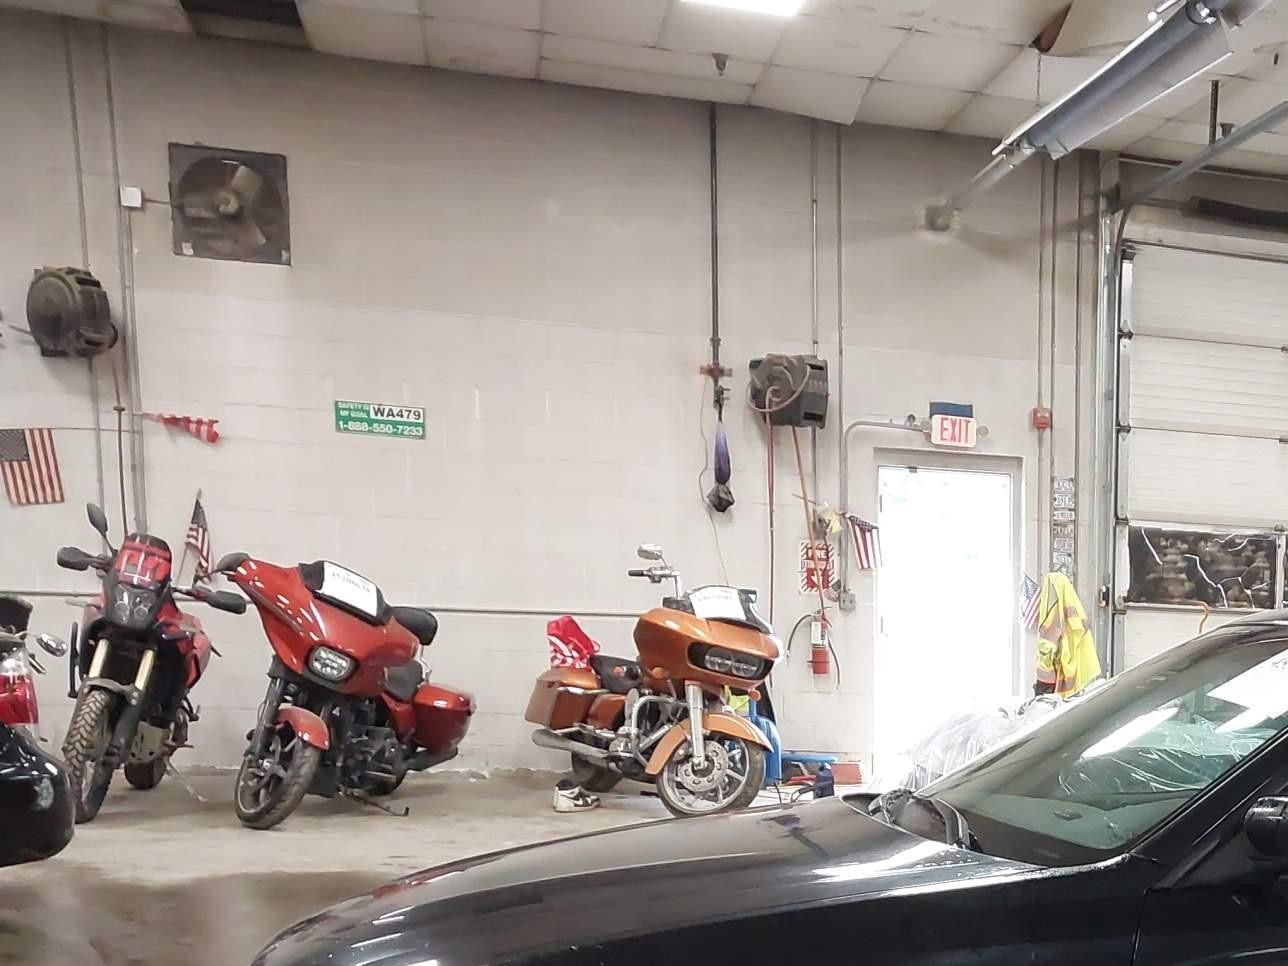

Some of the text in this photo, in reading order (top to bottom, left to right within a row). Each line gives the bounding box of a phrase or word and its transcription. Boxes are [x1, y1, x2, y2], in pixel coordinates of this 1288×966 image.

[372, 406, 421, 420] WA479
[338, 421, 423, 436] 1-888-550-7233
[940, 417, 971, 444] EXIT
